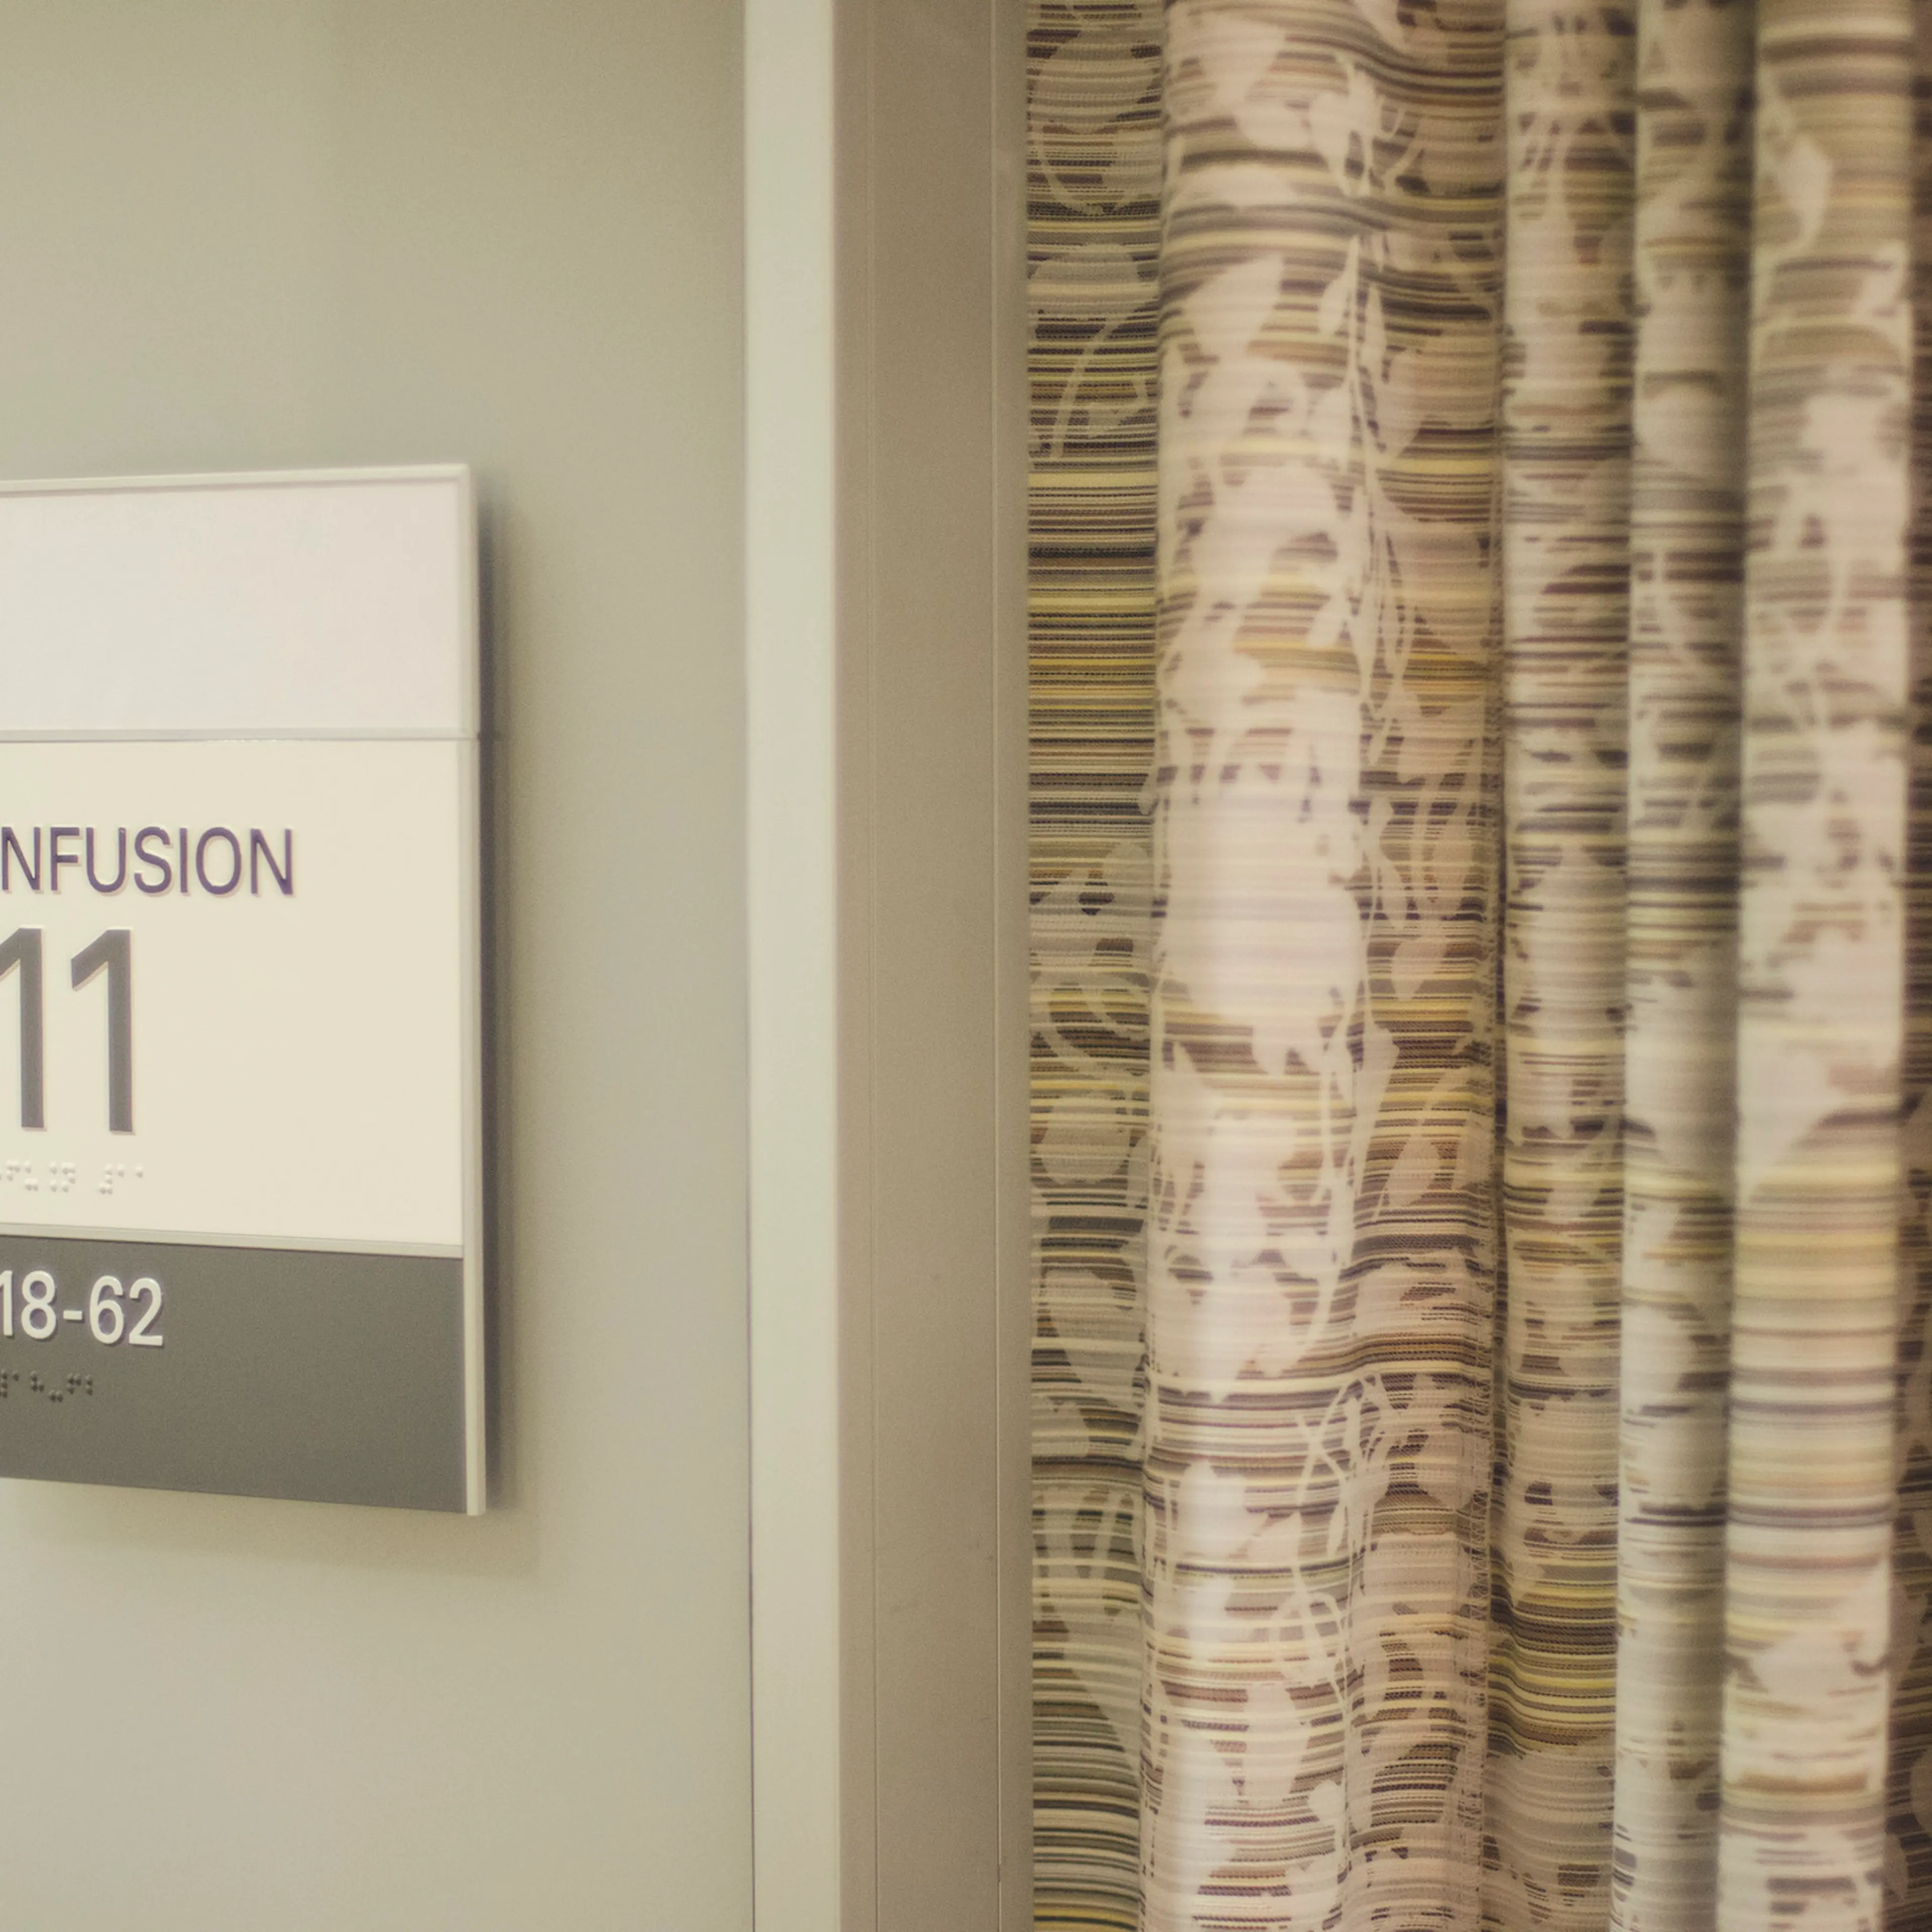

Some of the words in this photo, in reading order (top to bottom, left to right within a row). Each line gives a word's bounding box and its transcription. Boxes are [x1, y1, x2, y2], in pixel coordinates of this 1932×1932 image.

[1, 826, 293, 896] NFUSION
[0, 927, 133, 1133] 11
[0, 1270, 163, 1346] 18-62
